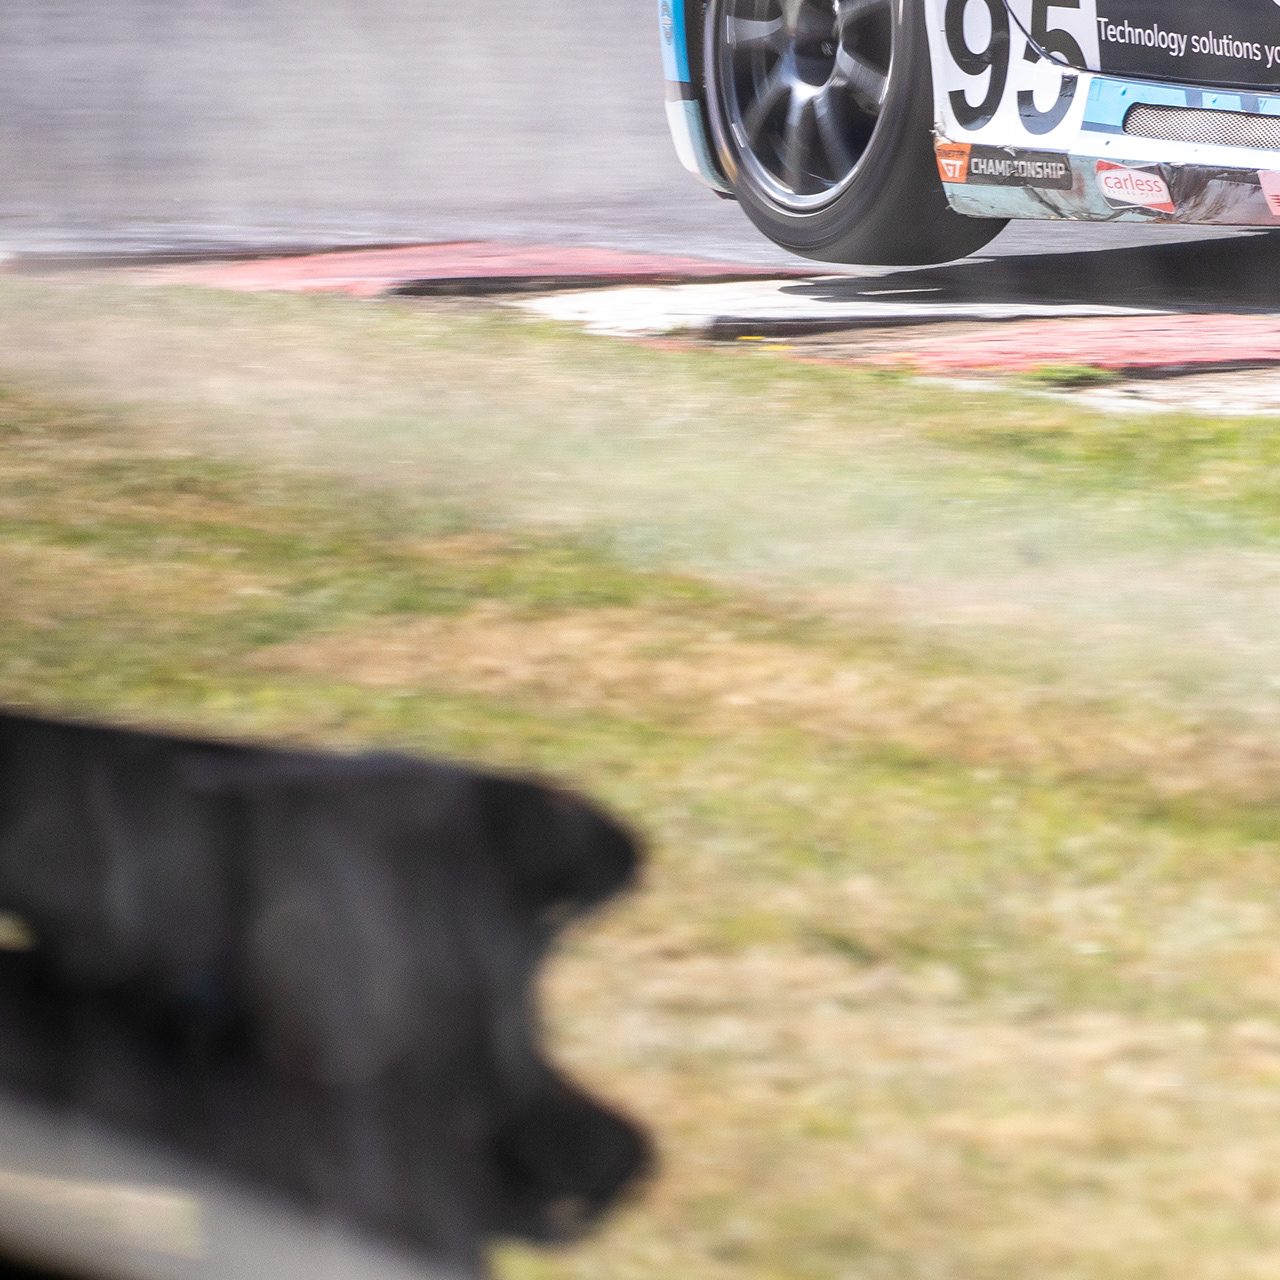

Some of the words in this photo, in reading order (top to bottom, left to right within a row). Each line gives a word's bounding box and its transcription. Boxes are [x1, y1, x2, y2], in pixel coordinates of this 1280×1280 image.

[1097, 17, 1187, 57] Technology
[1191, 30, 1261, 62] solutions
[1104, 174, 1162, 193] carless
